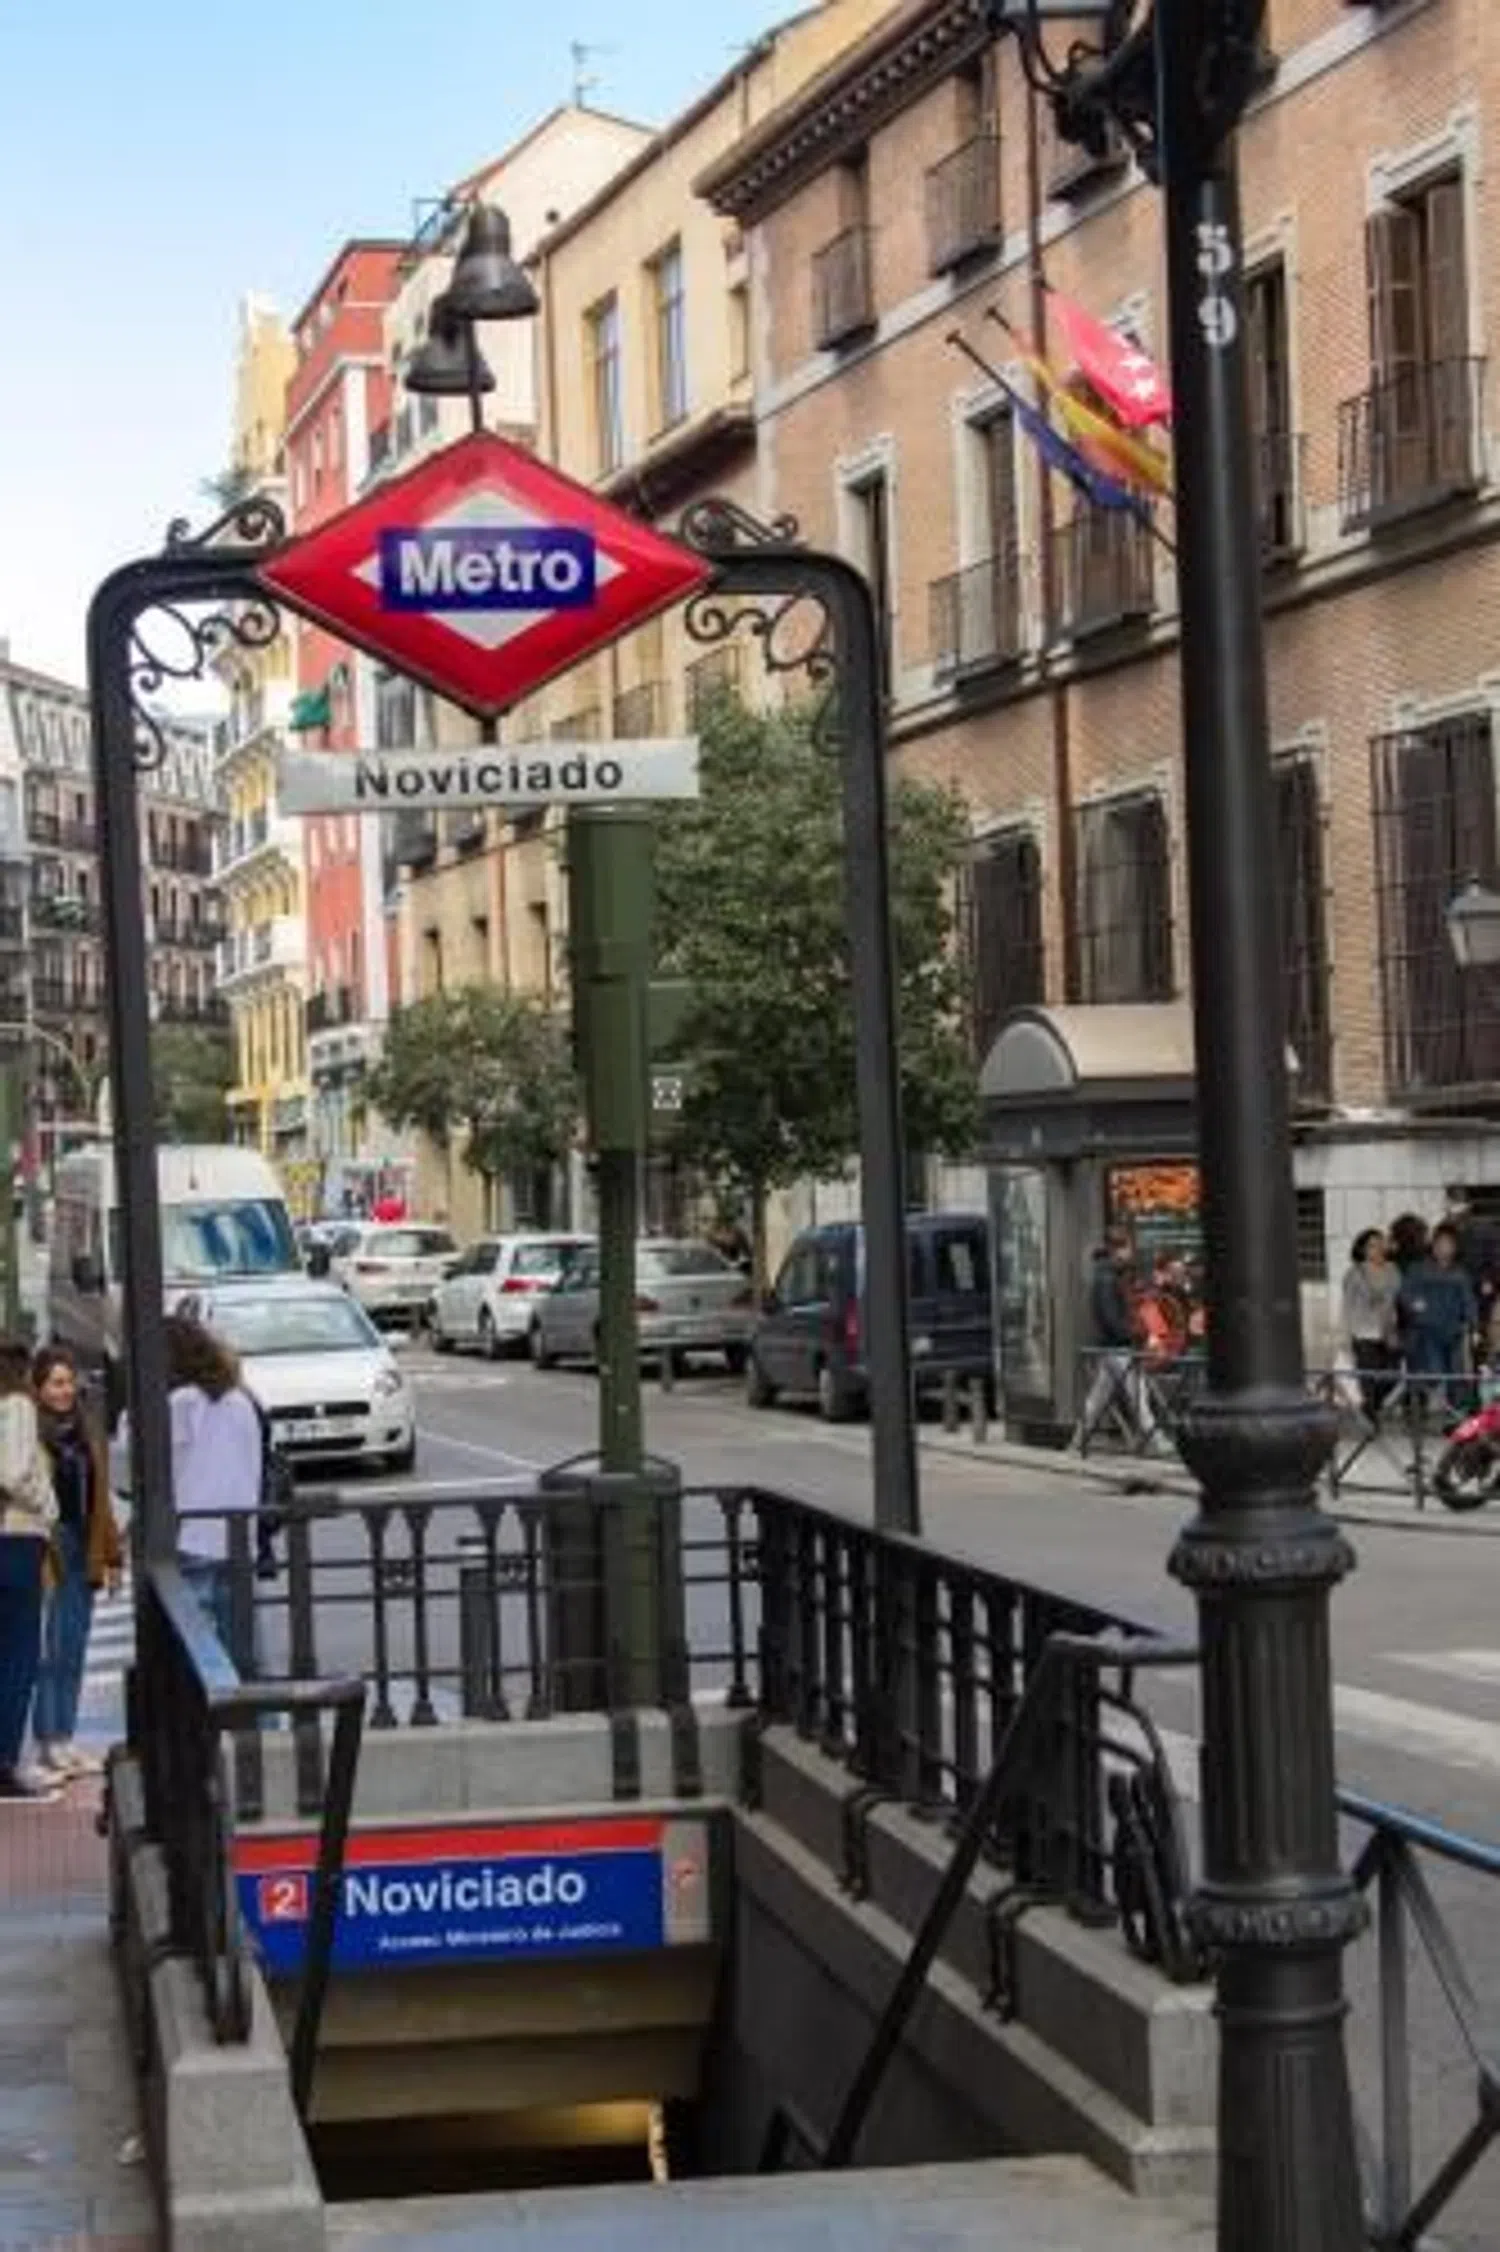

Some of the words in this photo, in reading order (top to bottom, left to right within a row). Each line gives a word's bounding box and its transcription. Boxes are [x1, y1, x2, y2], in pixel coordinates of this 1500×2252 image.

[400, 540, 582, 596] Metro
[355, 755, 623, 799] Noviciado
[274, 1882, 297, 1915] 2
[345, 1864, 586, 1917] Noviciado
